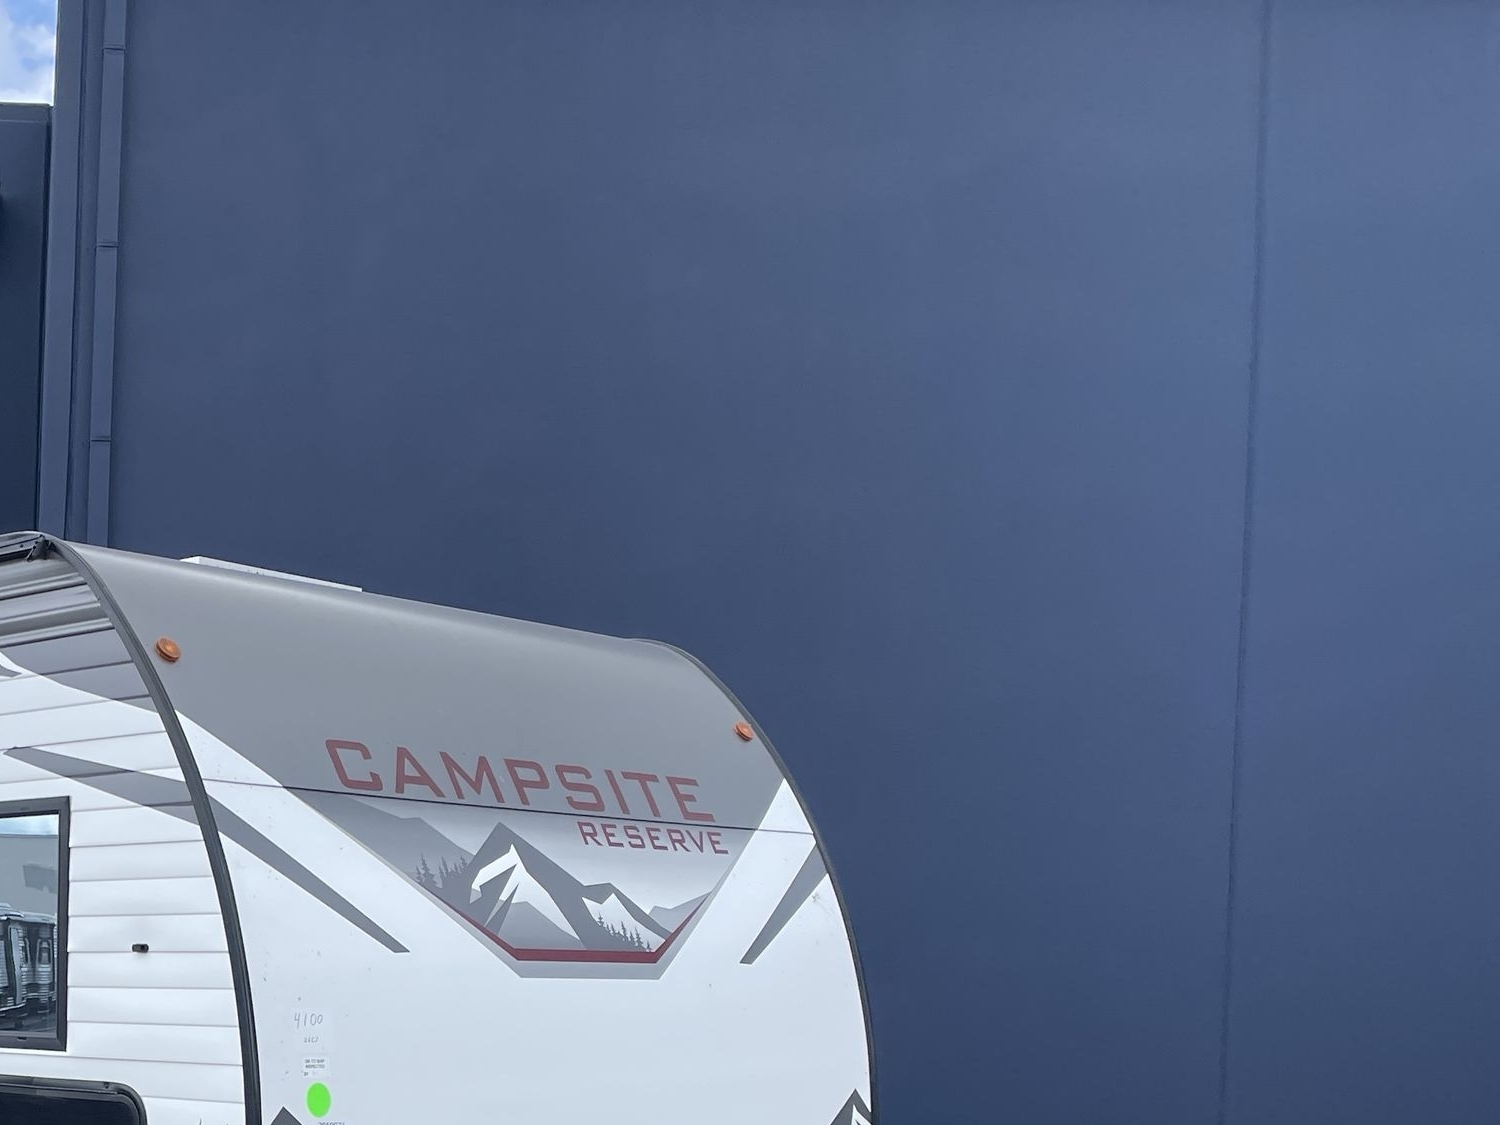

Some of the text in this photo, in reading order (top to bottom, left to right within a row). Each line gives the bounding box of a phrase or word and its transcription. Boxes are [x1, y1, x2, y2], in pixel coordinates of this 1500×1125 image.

[325, 739, 716, 822] CAMPSITE
[577, 820, 729, 855] RESERVE
[294, 1011, 324, 1029] 4100
